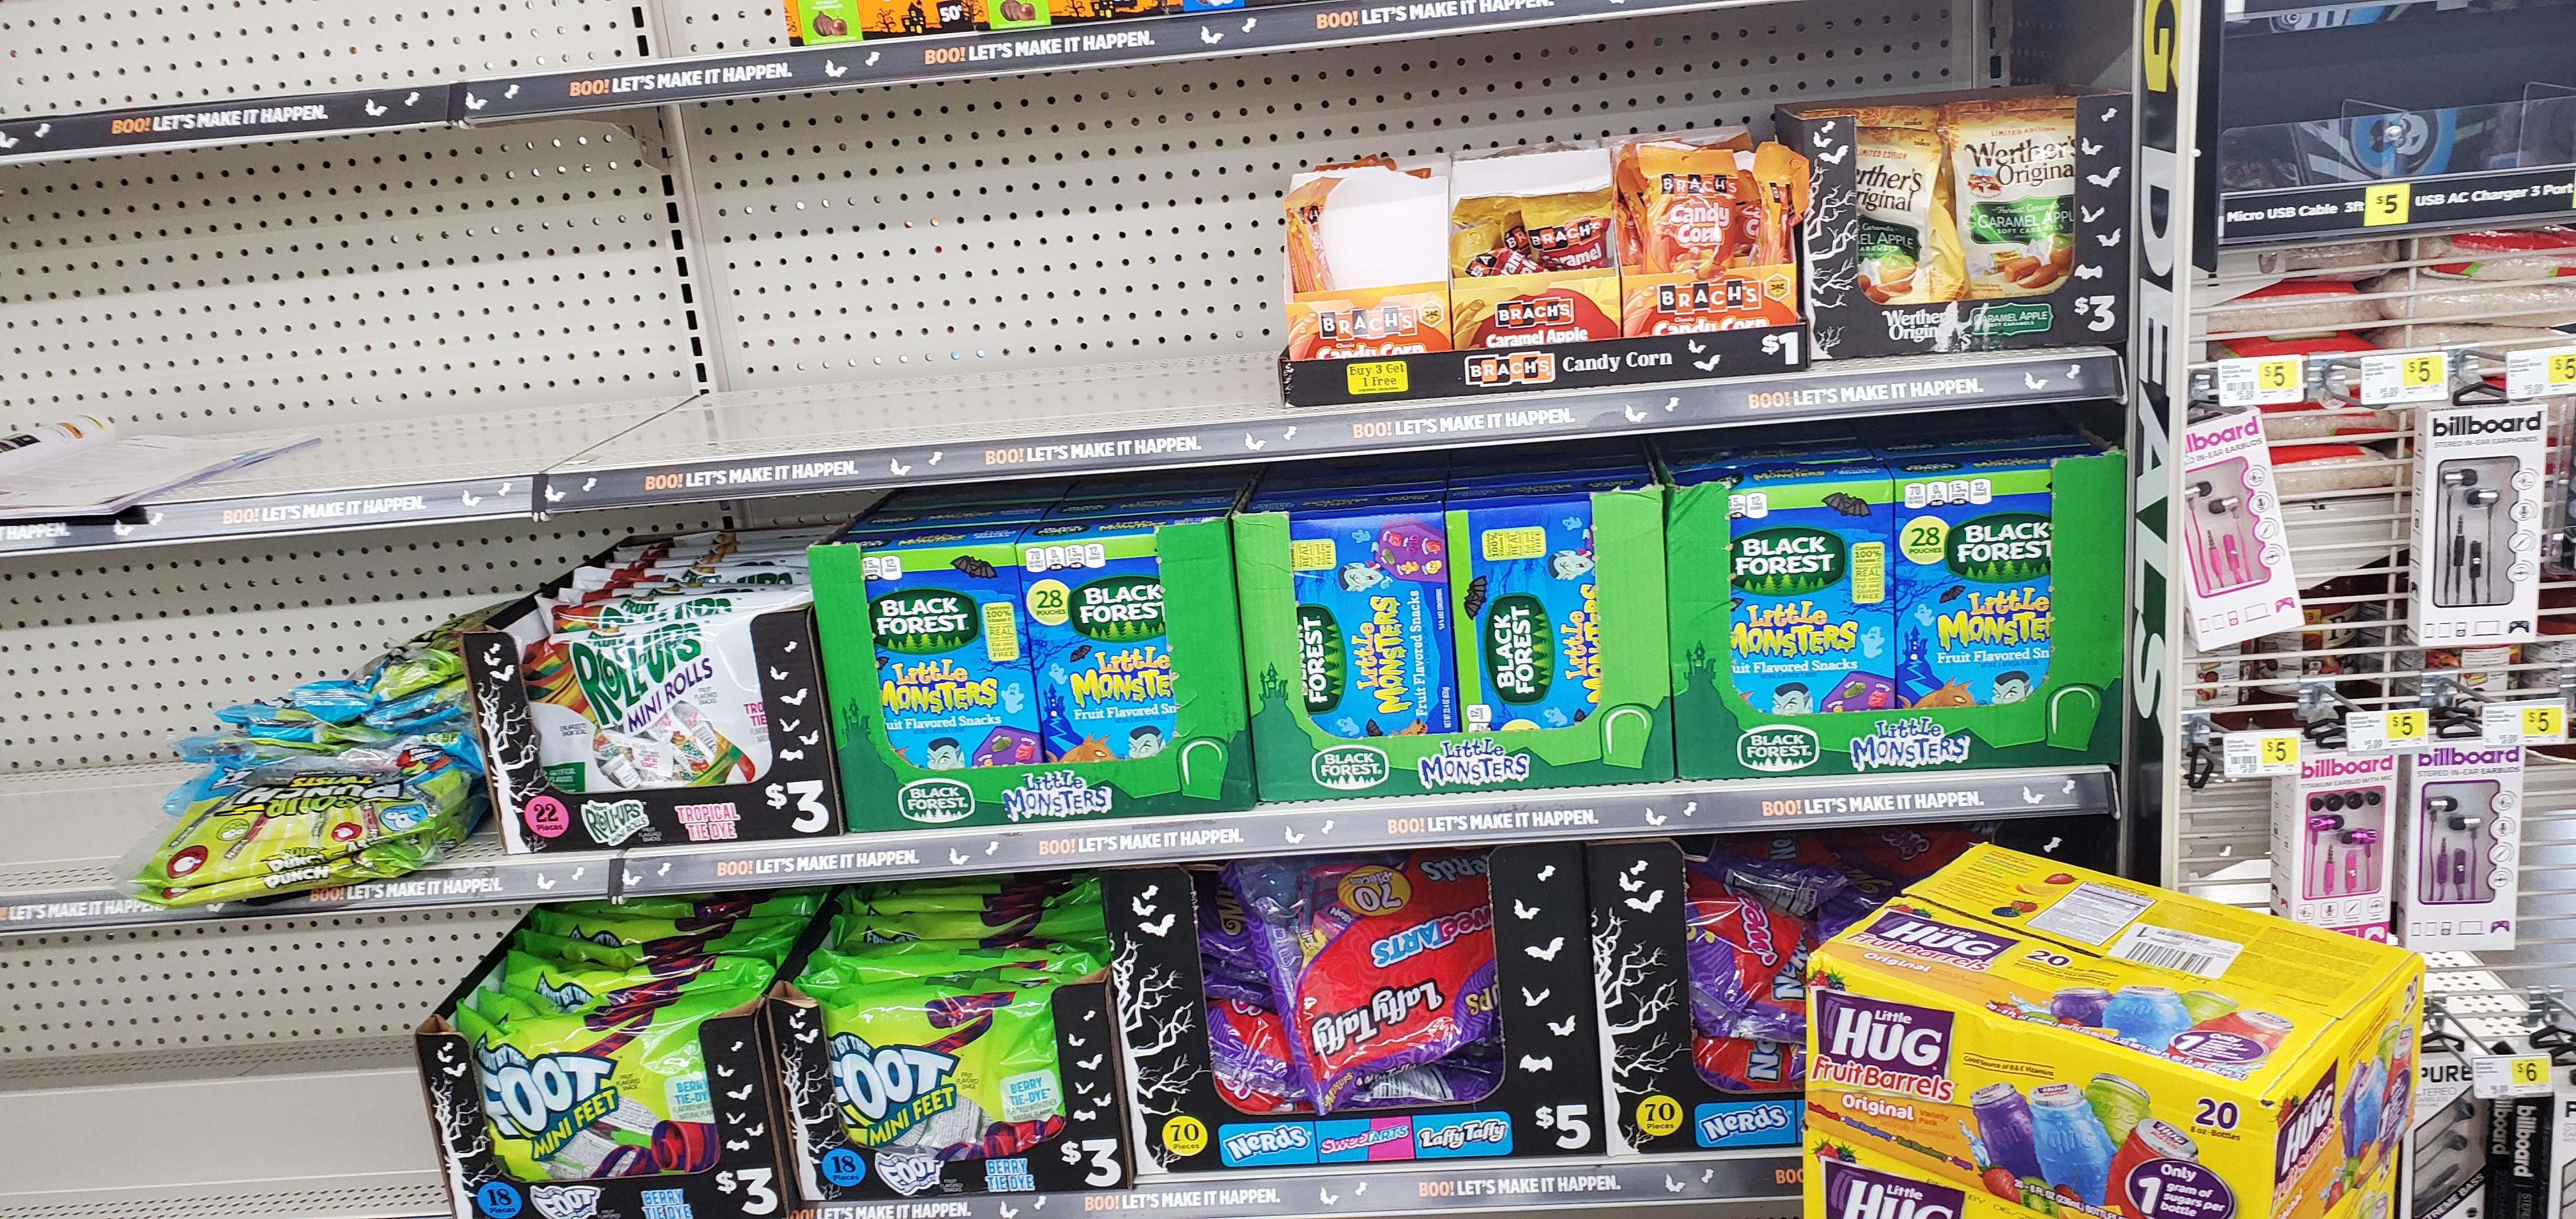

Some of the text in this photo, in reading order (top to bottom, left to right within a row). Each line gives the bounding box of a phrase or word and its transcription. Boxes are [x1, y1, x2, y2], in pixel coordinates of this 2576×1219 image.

[925, 31, 1154, 65] BOO! LET'S MAKE IT HAPPEN.
[112, 118, 151, 134] BOO!
[197, 111, 242, 128] MAKE
[243, 109, 259, 124] IT
[261, 105, 328, 123] HAPPEN.
[1998, 163, 2074, 187] Origina
[2376, 194, 2398, 214] $5
[2415, 183, 2573, 207] USB AC Charger 3 Port
[1670, 203, 1730, 226] Candy
[1977, 213, 2039, 229] CARAMEL
[2228, 208, 2264, 222] Micro
[2267, 207, 2296, 219] USB
[2299, 203, 2336, 216] Cable
[1678, 227, 1722, 243] Corn
[1878, 234, 1913, 248] APPLE
[1662, 285, 1758, 309] BRACH'S
[1498, 303, 1570, 321] BRACH'S
[2020, 310, 2047, 319] APPLE
[2074, 295, 2115, 331] $3
[1322, 312, 1414, 334] BRACH'S
[1486, 327, 1588, 348] Caramel Apple
[1761, 332, 1798, 364] $1
[1349, 364, 1404, 376] Buy 3 Get
[1470, 352, 1673, 377] BRACH'S Candy Corn
[2409, 360, 2429, 382] $5
[2556, 358, 2575, 385] $5
[1363, 377, 1397, 387] 1 Free
[2264, 365, 2285, 387] $5
[1748, 378, 1984, 409] BOO! LET'S MAKE IT HAPPEN.
[2135, 146, 2177, 721] DEALS
[2432, 411, 2540, 436] billboard
[645, 461, 859, 491] BOO! LET'S MAKE IT HAPPEN.
[1911, 527, 1940, 546] 28
[1959, 522, 2050, 542] BLACK
[1742, 536, 1825, 556] BLACK
[1736, 553, 1832, 576] FOREST
[1037, 590, 1062, 609] 28
[1085, 585, 1163, 604] BLACK
[881, 598, 958, 616] BLACK
[986, 610, 1009, 618] 100%
[877, 614, 967, 635] FOREST
[989, 627, 1012, 636] REAL
[1305, 617, 1327, 703] FOREST
[1351, 623, 1377, 691] Little
[1370, 595, 1413, 714] MONSTERS
[1494, 614, 1515, 689] BLACK
[1511, 606, 1533, 694] FOREST
[893, 659, 969, 685] Little
[1752, 659, 1858, 673] Flavored Snacks
[628, 700, 662, 732] MINI
[665, 658, 712, 696] ROLLS
[905, 715, 1001, 729] Flavored Snacks
[1878, 717, 1943, 738] Little
[2392, 716, 2412, 735] $5
[2528, 712, 2549, 732] $5
[1750, 732, 1804, 747] BLACK
[1851, 734, 1969, 770] MONSTERS
[2266, 742, 2286, 762] $5
[2419, 746, 2519, 766] billboard
[2301, 755, 2393, 779] billboard
[910, 786, 959, 798] BLACK
[1027, 774, 1084, 791] Little
[533, 803, 558, 822] 22
[765, 780, 829, 832] $3
[1004, 786, 1111, 818] MONSTERS
[1762, 790, 1984, 816] BOO! LET'S MAKE IT HAPPEN.
[675, 804, 740, 822] TROPICAL
[687, 821, 737, 840] TIE DYE
[717, 849, 919, 876] BOO! LET'S MAKE IT HAPPEN.
[1353, 884, 1402, 911] 70
[1892, 921, 2001, 958] HUG
[1863, 953, 1932, 972] Original
[2027, 951, 2070, 966] 20
[1312, 979, 1443, 1053] Laffy Taffy
[1874, 1009, 1913, 1025] Little
[1830, 1007, 1942, 1066] HUG
[2518, 1062, 2536, 1081] $6
[1010, 1077, 1041, 1094] BERRY
[1842, 1093, 1914, 1122] Original
[2196, 1099, 2237, 1129] 20
[533, 1090, 617, 1158] MINI FEET
[1171, 1124, 1199, 1141] 70
[1535, 1105, 1590, 1149] $5
[2513, 1105, 2537, 1177] billboard
[832, 1156, 855, 1173] 18
[986, 1158, 1027, 1175] BERRY
[1061, 1138, 1121, 1186] $3
[2161, 1163, 2196, 1181] Only
[716, 1168, 778, 1215] $3
[986, 1174, 1034, 1192] TIE DYE
[1418, 1175, 1621, 1197] BOO! LET'S MAKE IT HAPPEN.
[1887, 1184, 1923, 1199] Little
[2166, 1183, 2214, 1197] gram of
[2138, 1177, 2161, 1213] 1
[2163, 1193, 2225, 1213] sugars per
[2160, 1202, 2197, 1217] bottle
